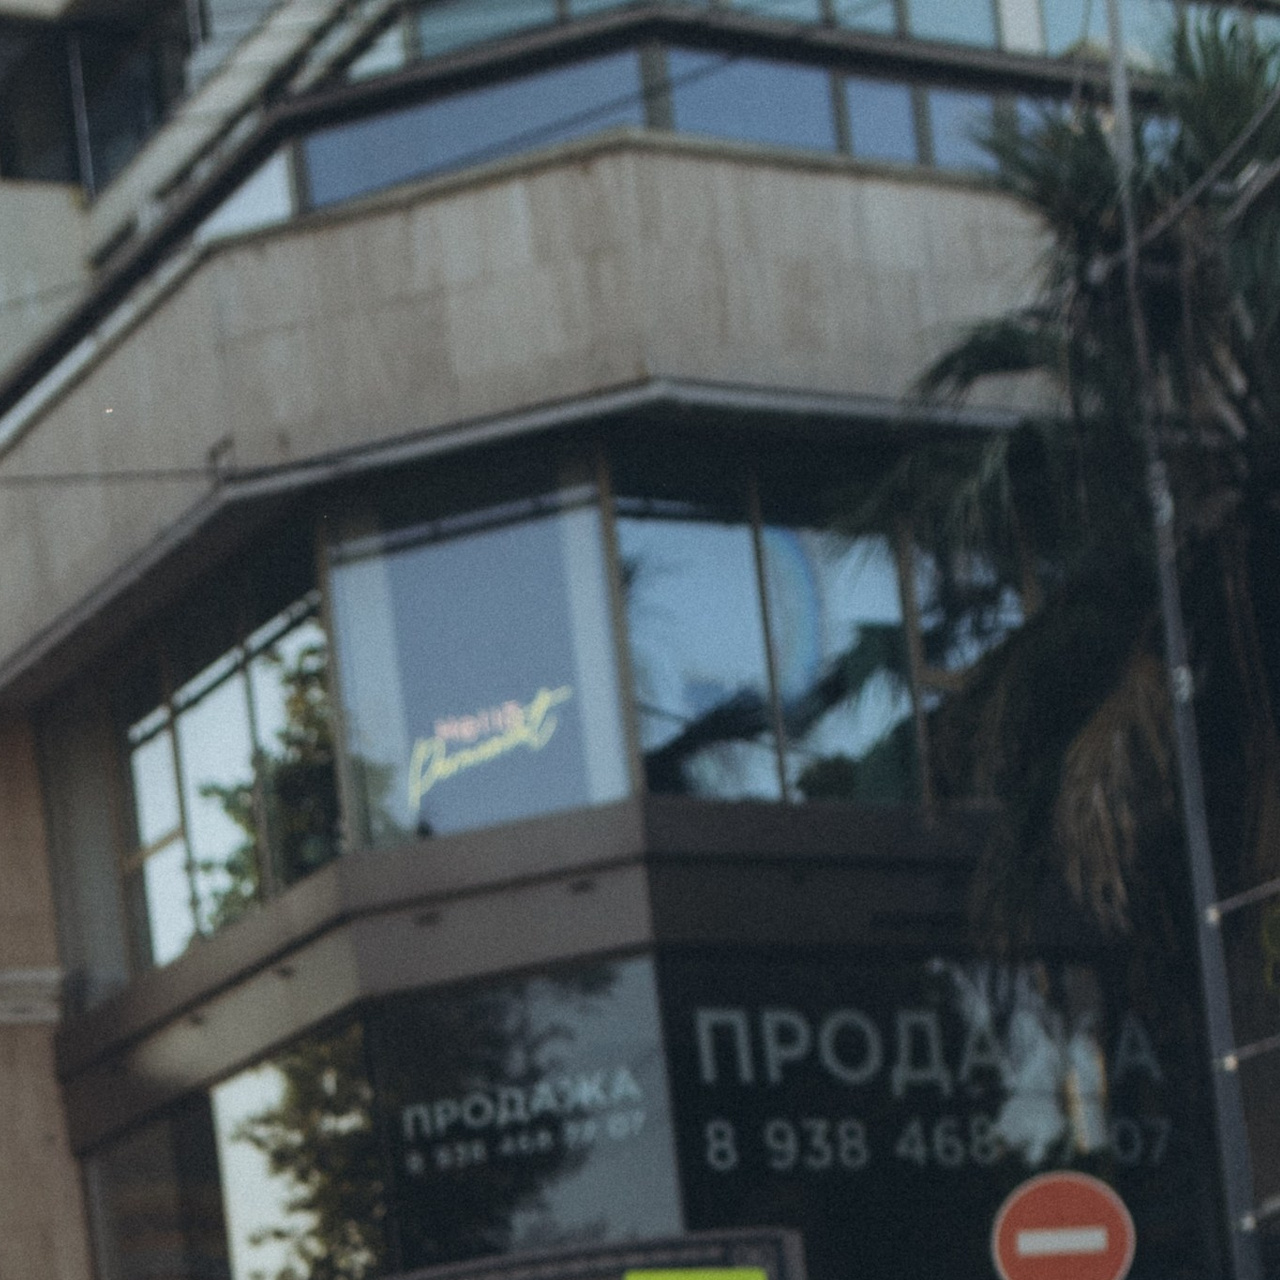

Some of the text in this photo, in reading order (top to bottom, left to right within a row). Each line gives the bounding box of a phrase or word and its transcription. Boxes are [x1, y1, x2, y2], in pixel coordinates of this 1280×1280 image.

[695, 1007, 1163, 1097] ПРОДАА
[402, 1065, 644, 1141] ПРОДАЖА
[704, 1120, 739, 1171] 8
[763, 1119, 870, 1170] 938
[895, 1117, 1000, 1167] 468
